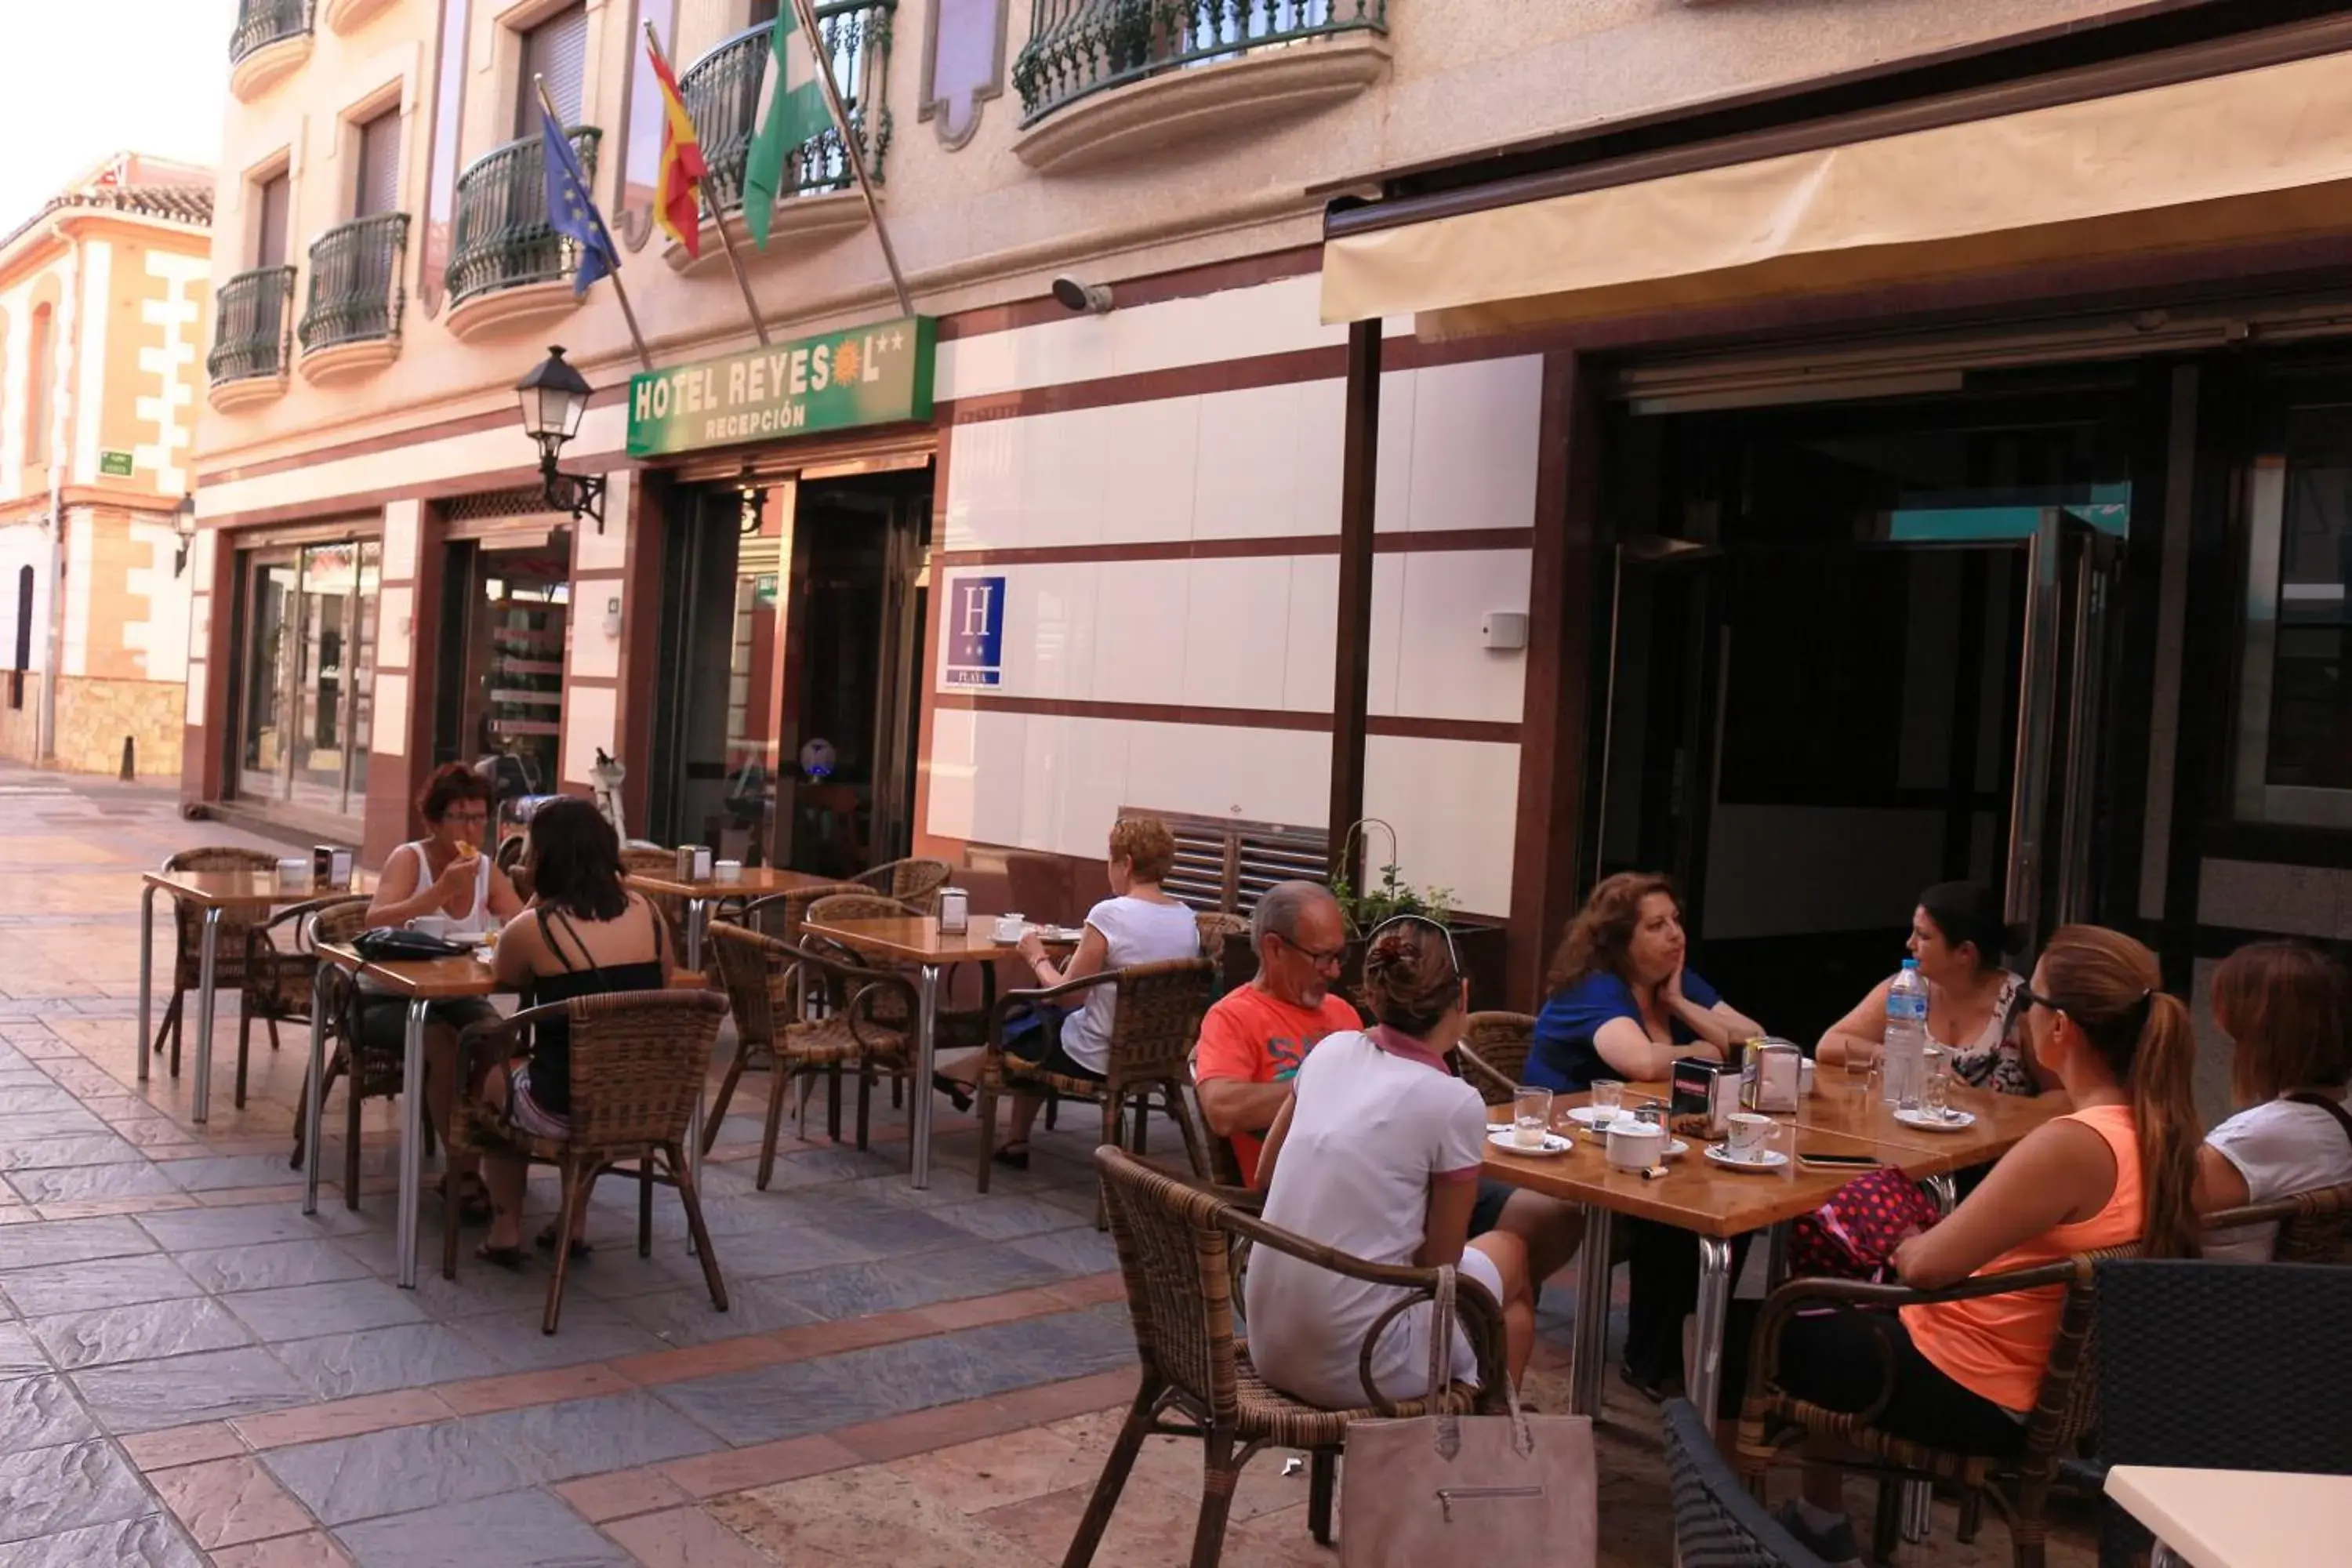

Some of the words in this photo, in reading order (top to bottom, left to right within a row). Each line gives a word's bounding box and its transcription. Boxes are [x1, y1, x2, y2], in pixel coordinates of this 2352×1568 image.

[634, 367, 717, 422] HOTEL
[705, 399, 806, 440] RECEPCIÓN
[960, 585, 993, 636] H
